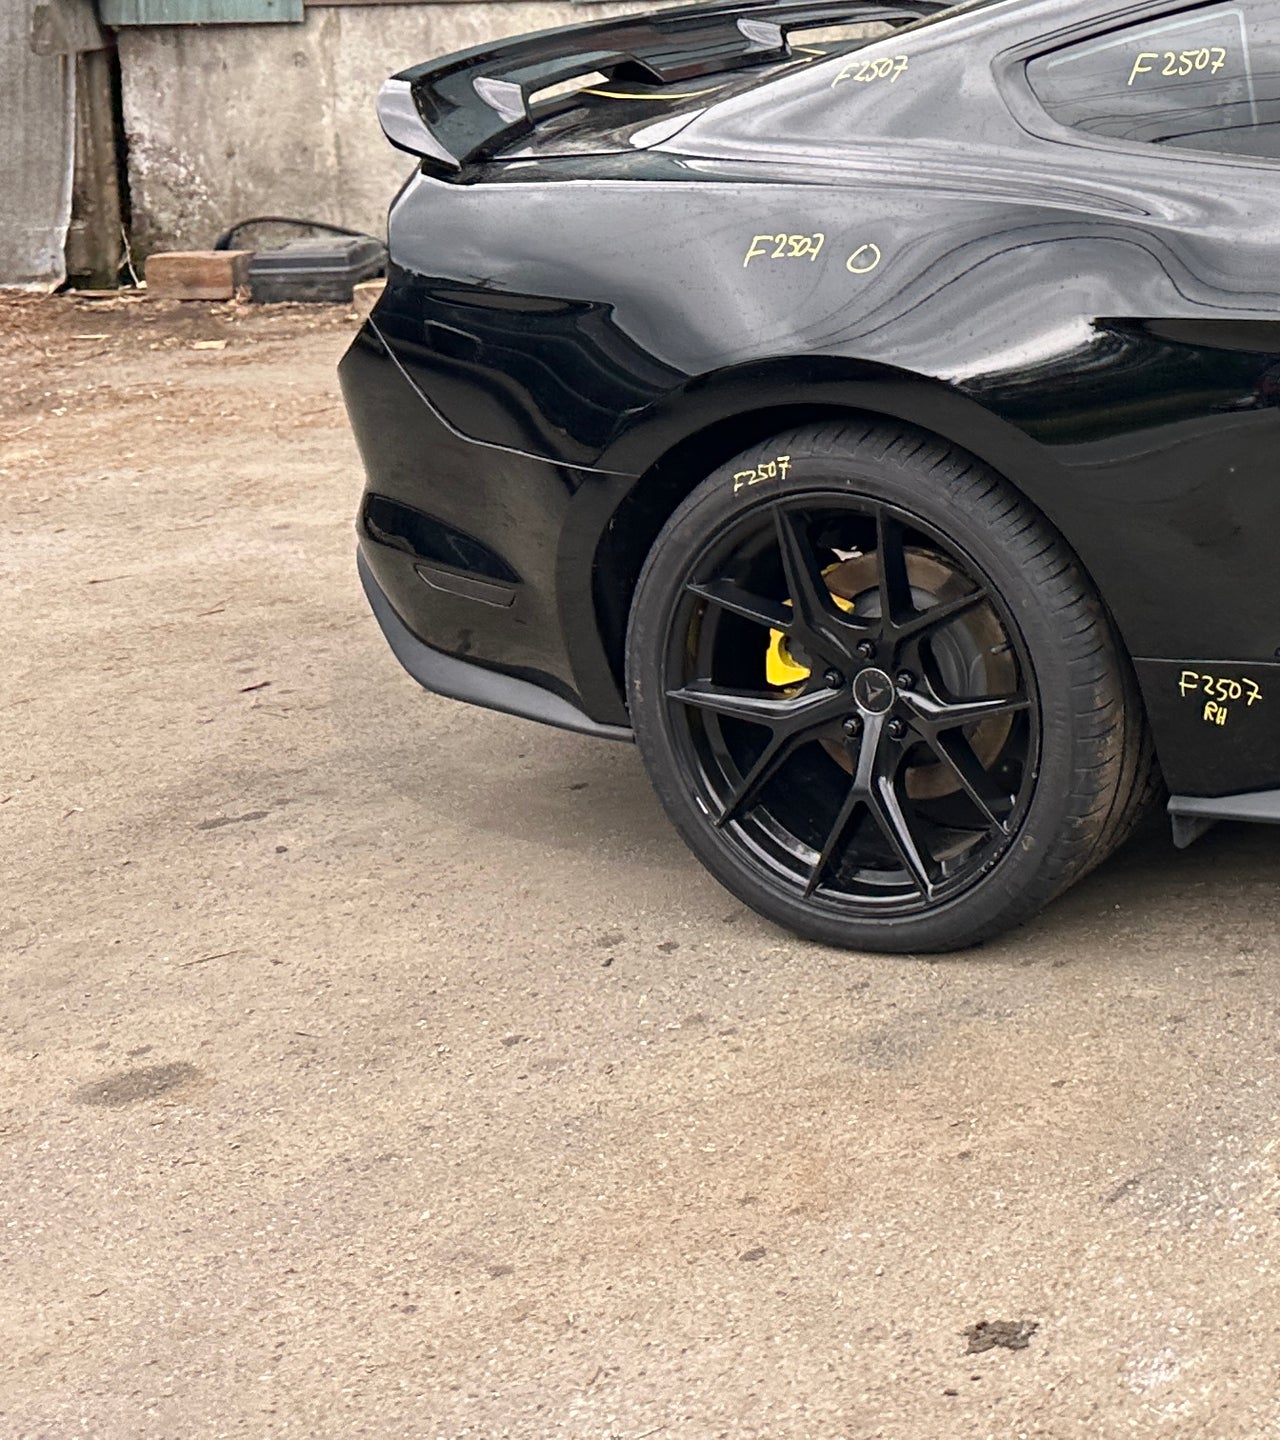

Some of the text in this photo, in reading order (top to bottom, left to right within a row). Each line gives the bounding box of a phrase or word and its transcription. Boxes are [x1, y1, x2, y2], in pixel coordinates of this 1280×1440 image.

[831, 55, 908, 88] F2507
[1128, 47, 1226, 85] F2507
[744, 233, 825, 267] F2507
[734, 455, 792, 493] F2507
[1178, 670, 1262, 706] F2507
[1203, 700, 1228, 725] RH
